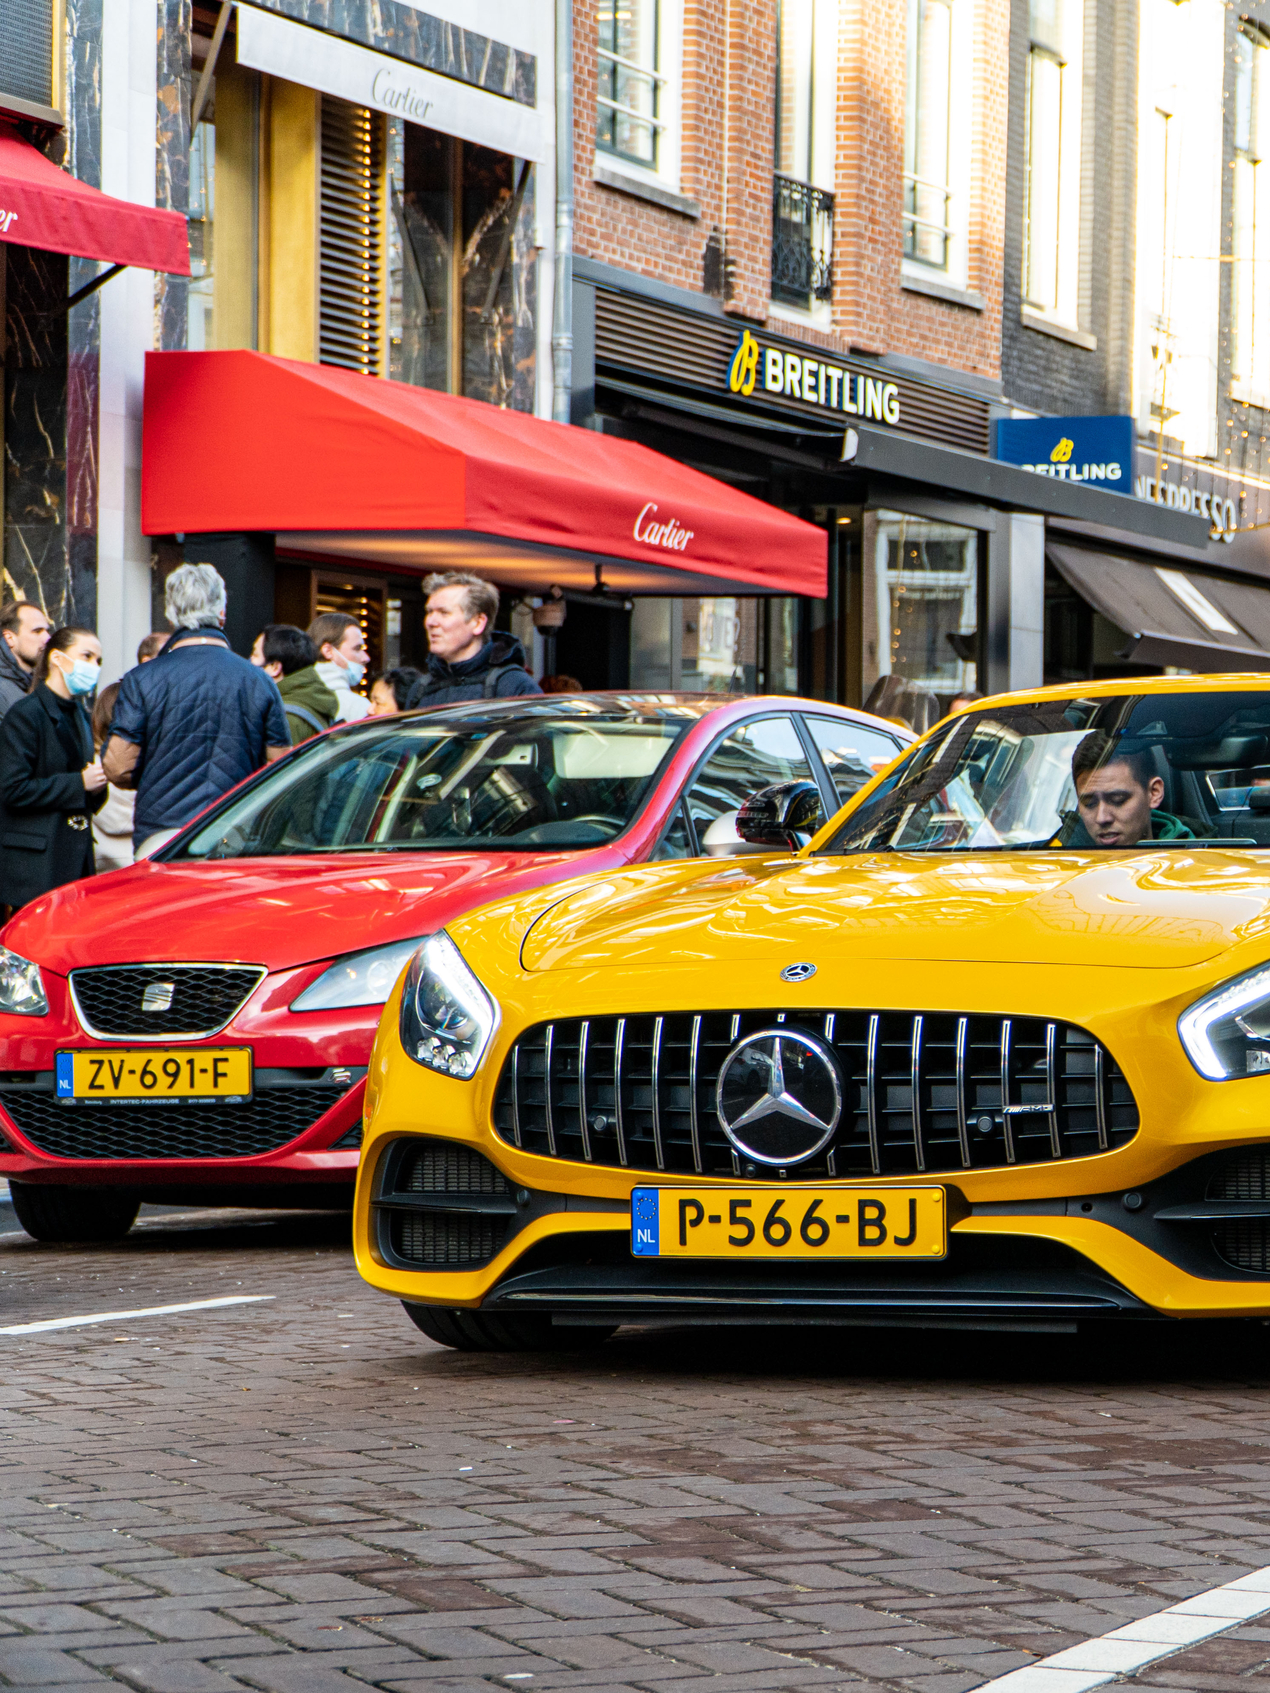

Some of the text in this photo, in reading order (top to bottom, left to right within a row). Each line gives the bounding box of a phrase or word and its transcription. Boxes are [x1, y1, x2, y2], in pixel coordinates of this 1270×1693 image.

[371, 68, 433, 119] Cartier
[765, 347, 900, 425] BREITLING
[633, 502, 695, 552] Cartier
[59, 1058, 230, 1090] NL ZV-691-F
[636, 1198, 918, 1247] NL P-566-BJ
